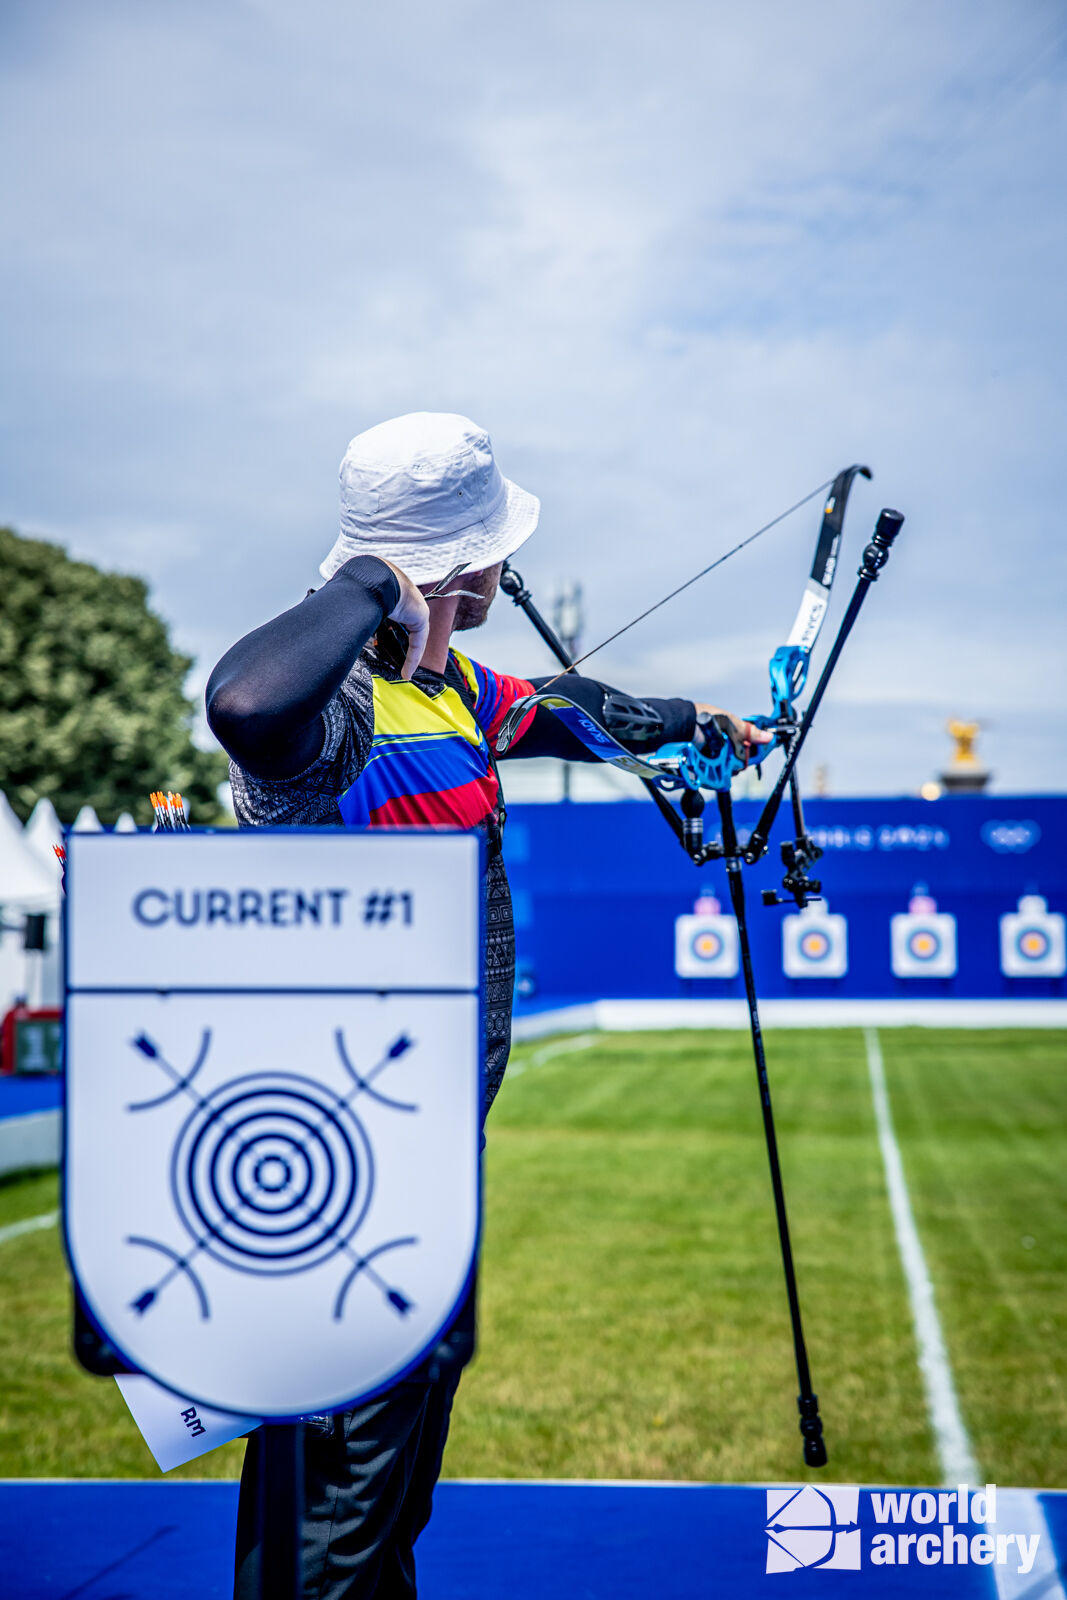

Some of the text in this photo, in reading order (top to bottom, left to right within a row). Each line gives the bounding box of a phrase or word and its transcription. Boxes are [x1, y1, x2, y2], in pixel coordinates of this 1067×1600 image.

[132, 888, 414, 928] CURRENT #1
[180, 1406, 206, 1437] RM
